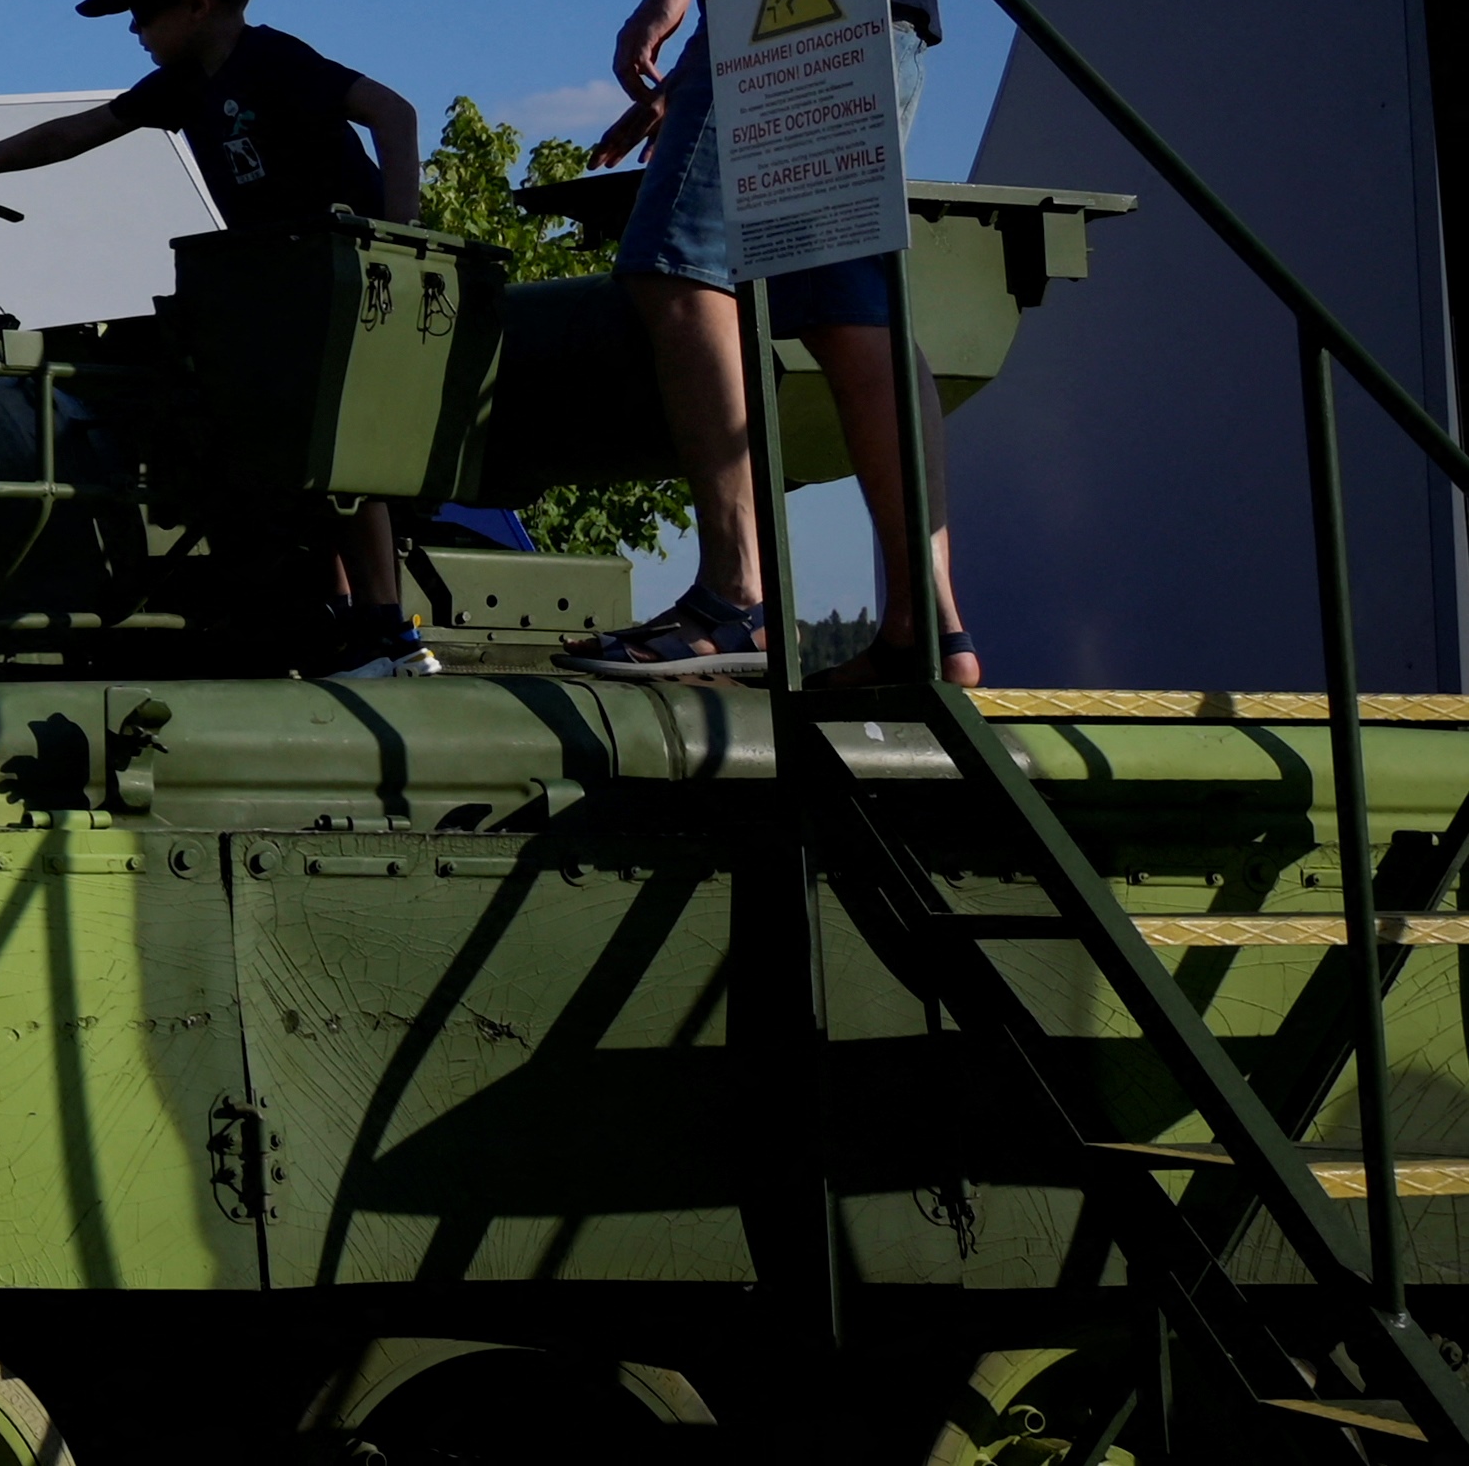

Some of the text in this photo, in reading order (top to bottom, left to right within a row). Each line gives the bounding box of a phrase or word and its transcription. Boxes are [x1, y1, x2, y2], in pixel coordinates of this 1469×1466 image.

[715, 18, 885, 77] ВНИМАНИЕ! ОПАСНОСТЬ!
[738, 65, 800, 94] CAUTION!
[803, 48, 865, 78] DANGER!
[732, 117, 782, 145] БУДЬТЕ
[784, 93, 877, 132] ОСТОРОЖНЫ
[737, 175, 759, 195] BE
[761, 158, 832, 189] CAREFUL
[834, 145, 886, 173] WHILE
